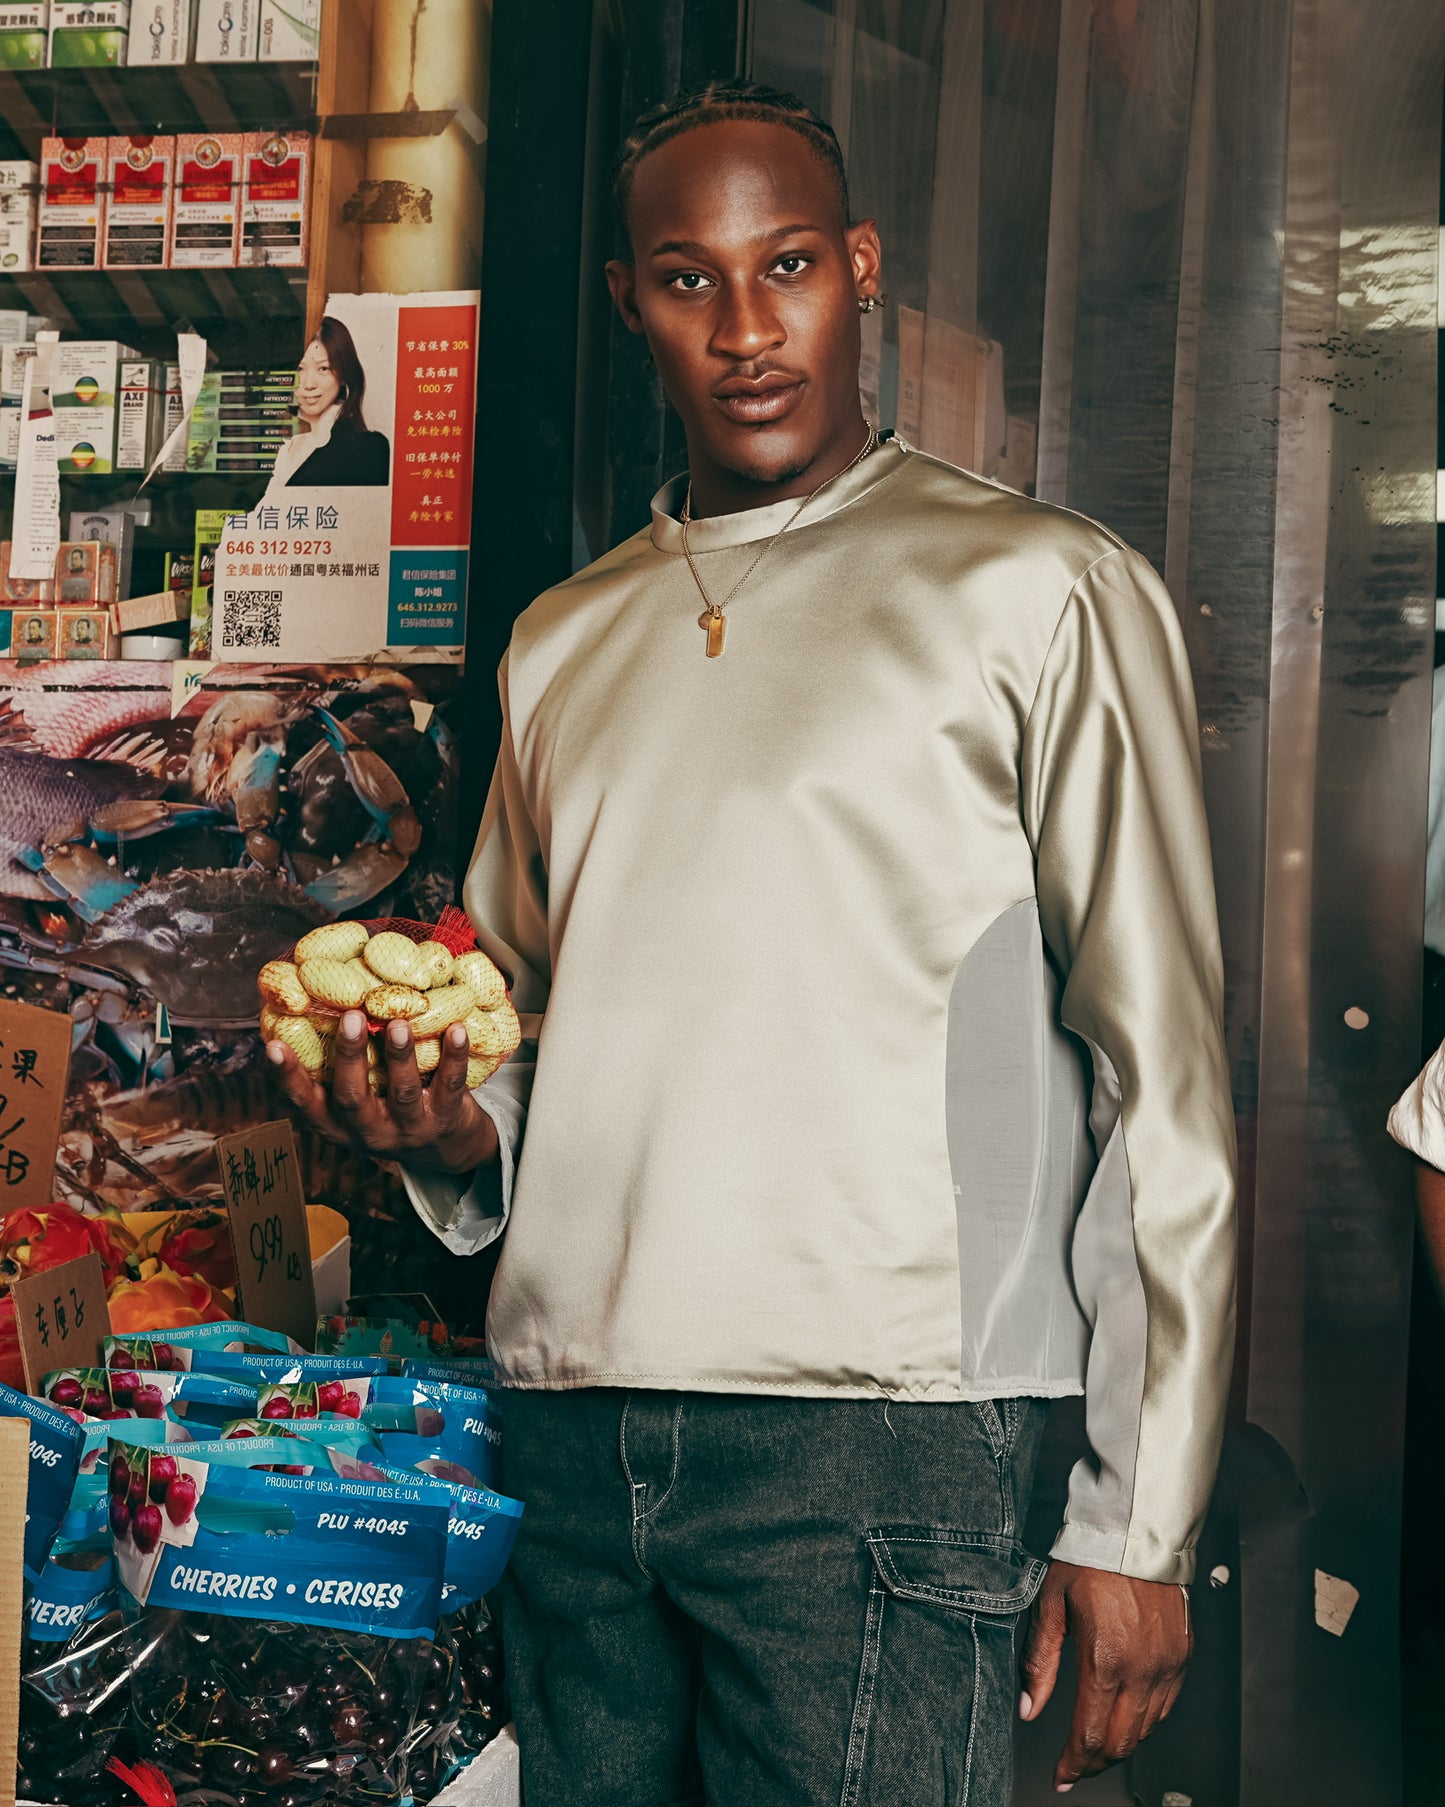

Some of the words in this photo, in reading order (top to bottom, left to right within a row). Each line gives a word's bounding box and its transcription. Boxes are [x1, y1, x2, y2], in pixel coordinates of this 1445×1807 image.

[405, 340, 450, 353] 节省保费
[452, 340, 470, 351] 30%
[418, 384, 441, 394] 1000
[443, 383, 454, 394] 万
[124, 392, 144, 401] AXE
[169, 396, 183, 404] AX
[413, 409, 457, 420] 各大公司
[421, 495, 443, 506] 真正
[227, 505, 340, 530] 君信保险
[409, 511, 454, 522] 寿险专家
[226, 541, 255, 555] 646
[260, 541, 288, 555] 312
[293, 541, 332, 555] 9273
[226, 563, 380, 577] 全美最优价通国粤英福州话
[402, 569, 457, 580] 君信保险集团
[414, 587, 443, 597] 陈小姐
[397, 602, 458, 612] 646.312.9273
[400, 618, 454, 628] 扫码微信服务
[242, 1356, 274, 1367] PRODUCT
[275, 1358, 285, 1367] OF
[285, 1358, 299, 1368] USA
[304, 1359, 332, 1368] PRODUIT
[333, 1360, 345, 1368] DES
[427, 1367, 453, 1379] PRODUCT
[453, 1371, 461, 1380] OF
[461, 1373, 474, 1382] USA
[229, 1386, 257, 1399] PRODUC
[420, 1384, 452, 1397] PRODUCT
[453, 1388, 463, 1398] OF
[463, 1390, 478, 1401] USA
[4, 1392, 18, 1406] USA
[19, 1400, 51, 1422] PRODUIT
[48, 1415, 63, 1430] DES
[463, 1417, 485, 1435] PLU
[265, 1476, 305, 1489] PRODUCT
[305, 1480, 316, 1490] OF
[317, 1481, 334, 1492] USA
[340, 1483, 376, 1497] PRODUIT
[376, 1486, 393, 1499] DES
[399, 1473, 410, 1484] OF
[409, 1475, 424, 1487] USA
[461, 1489, 478, 1503] DES
[316, 1512, 350, 1530] PLU
[353, 1517, 409, 1536] #4045
[447, 1517, 485, 1540] 4045
[170, 1565, 278, 1601] CHERRIES
[304, 1579, 404, 1609] CERISES
